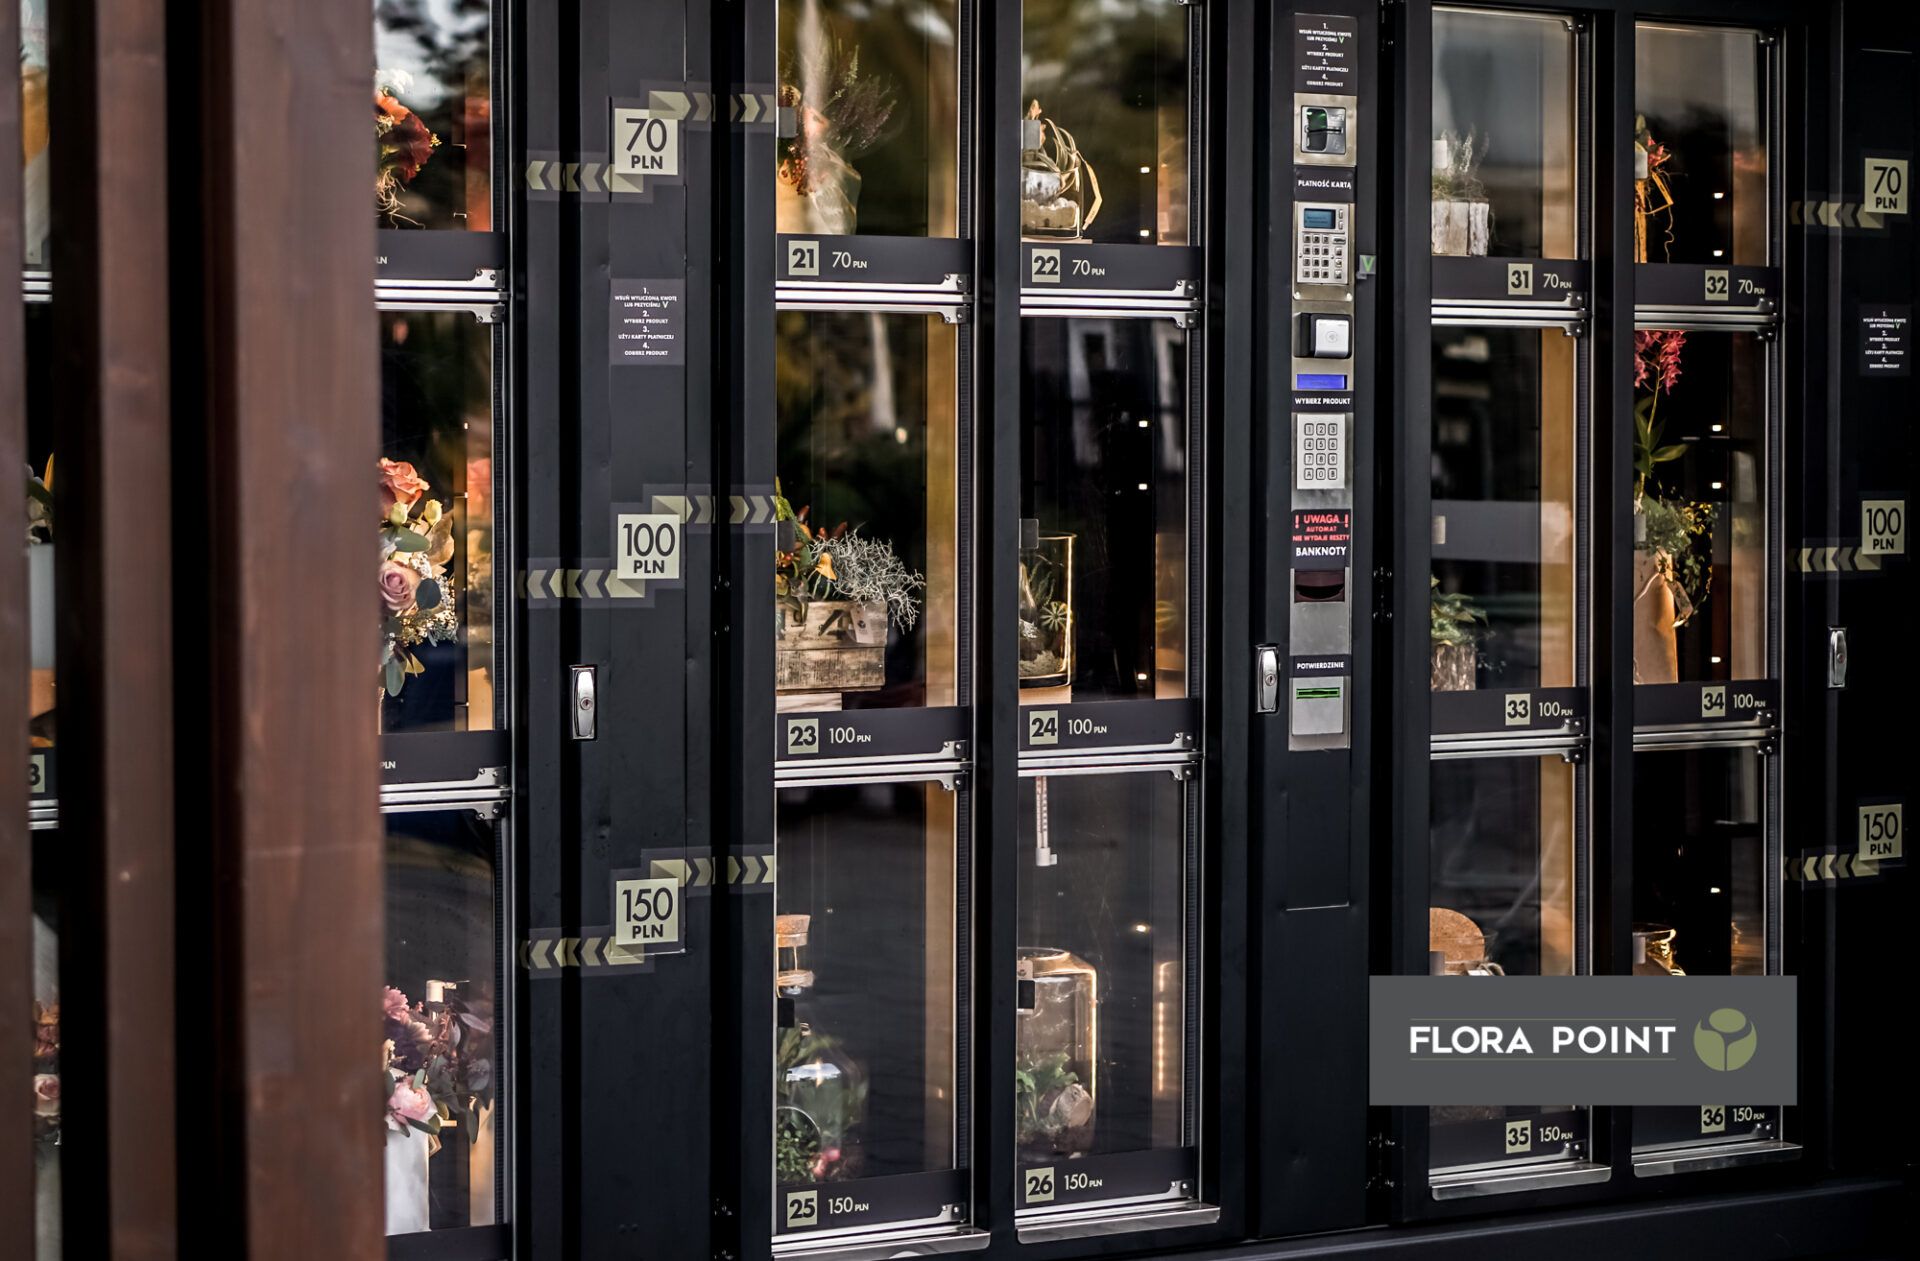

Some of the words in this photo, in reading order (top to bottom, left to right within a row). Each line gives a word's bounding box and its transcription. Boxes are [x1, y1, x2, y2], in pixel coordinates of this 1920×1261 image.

[626, 118, 667, 152] 70
[631, 155, 663, 169] PLN
[1331, 181, 1351, 189] KARTĄ
[1874, 166, 1901, 194] 70
[1876, 197, 1897, 209] PLN
[792, 248, 814, 268] 21
[832, 252, 851, 268] 70
[1034, 256, 1058, 275] 22
[1362, 256, 1375, 272] V
[1072, 260, 1090, 275] 70
[1092, 268, 1105, 276] PLN
[1511, 270, 1529, 288] 31
[1543, 273, 1559, 288] 70
[1707, 276, 1727, 294] 32
[1738, 280, 1753, 294] 70
[1304, 514, 1340, 523] UWAGA
[1866, 508, 1901, 536] 100
[623, 523, 675, 556] 100
[1873, 538, 1894, 550] PLN
[1296, 546, 1346, 557] BANKNOTY
[634, 560, 664, 573] PLN
[1297, 661, 1345, 670] POTWIERDZENIE
[1507, 700, 1528, 718] 33
[1539, 702, 1560, 716] 100
[1704, 693, 1724, 710] 34
[1733, 694, 1753, 708] 100
[1032, 718, 1057, 737] 24
[1068, 719, 1092, 734] 100
[790, 726, 816, 746] 23
[829, 727, 855, 743] 100
[1863, 812, 1898, 841] 150
[1870, 842, 1892, 855] PLN
[622, 887, 673, 922] 150
[632, 924, 663, 939] PLN
[1703, 1108, 1723, 1126] 36
[1733, 1107, 1752, 1122] 150
[1508, 1127, 1529, 1146] 35
[1540, 1126, 1560, 1142] 150
[1028, 1175, 1052, 1196] 26
[1064, 1173, 1088, 1190] 150
[1089, 1179, 1102, 1187] PLN
[789, 1198, 815, 1219] 25
[828, 1197, 853, 1214] 150
[855, 1203, 869, 1211] PLN
